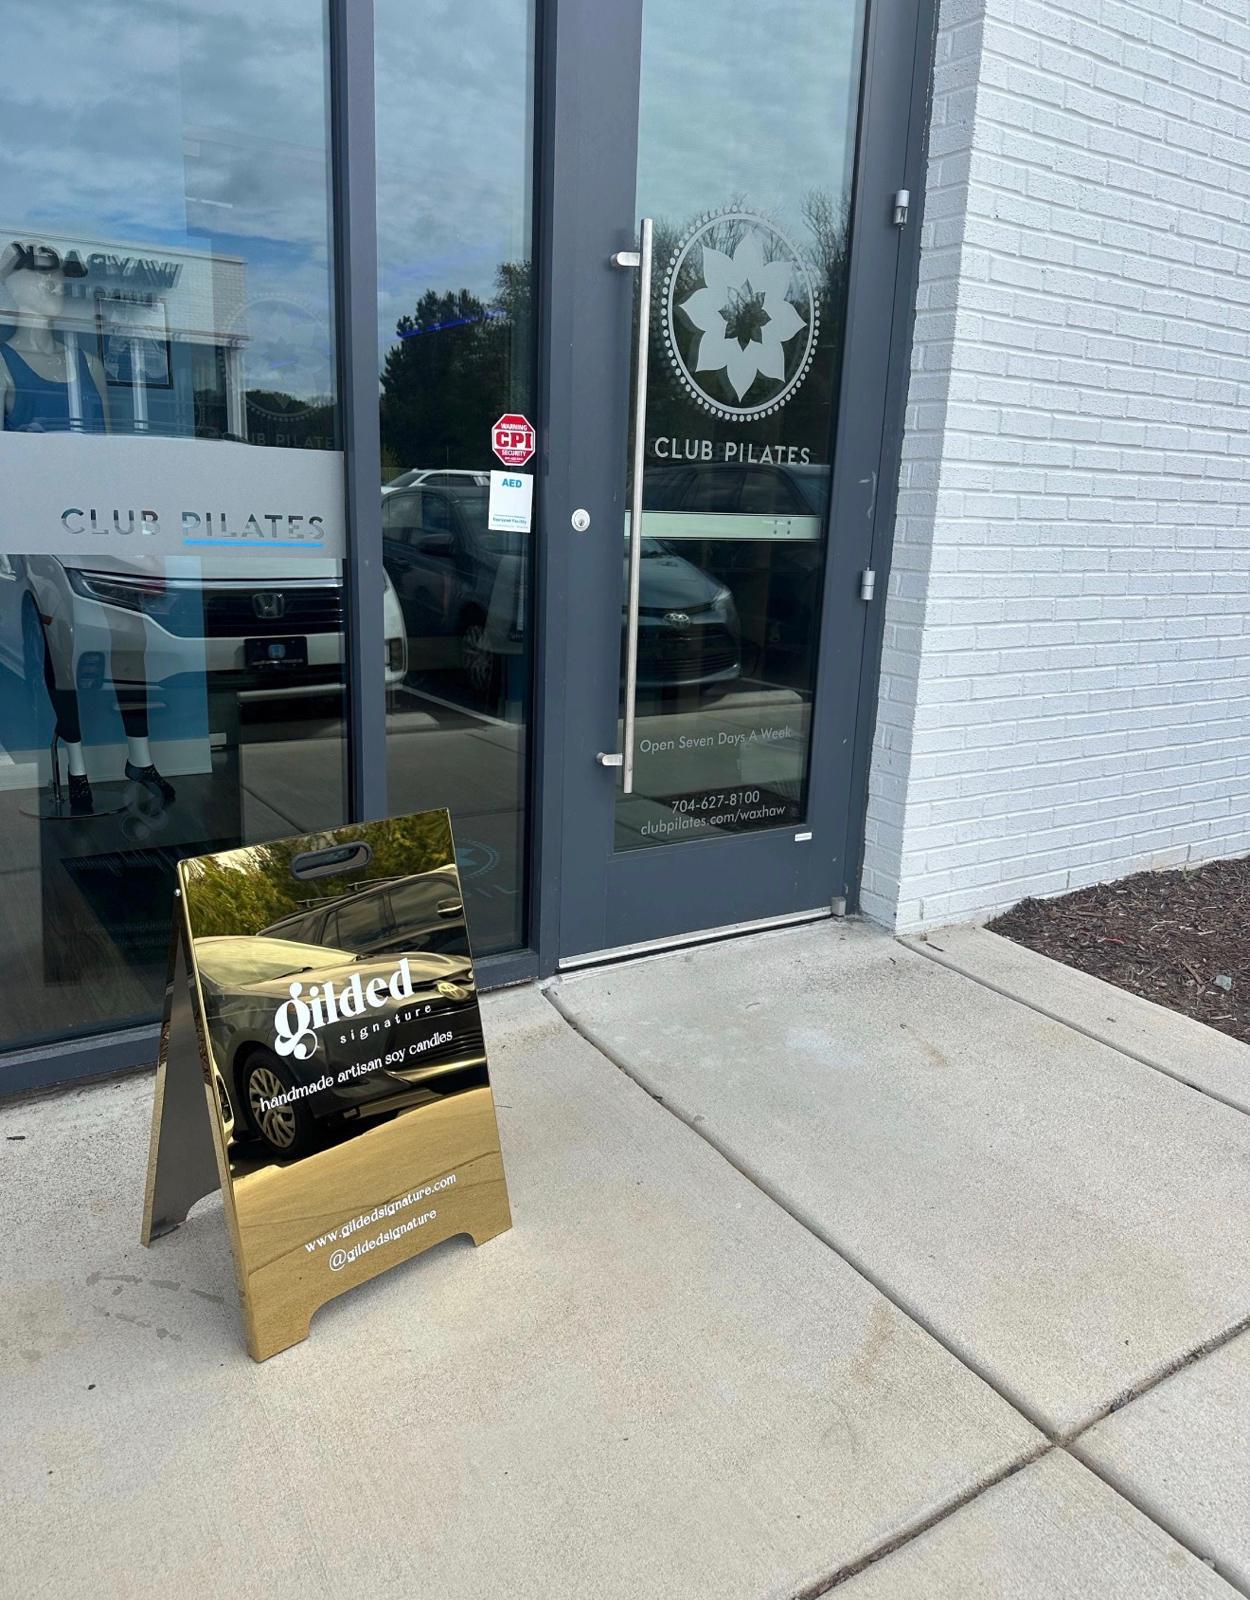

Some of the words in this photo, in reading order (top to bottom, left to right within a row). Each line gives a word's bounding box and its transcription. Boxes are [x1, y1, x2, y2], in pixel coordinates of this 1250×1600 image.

[495, 431, 532, 449] CPI
[501, 423, 528, 431] WARNING
[654, 436, 713, 460] CLUB
[724, 441, 811, 465] PILATES
[502, 478, 522, 488] AED
[61, 508, 161, 536] CLUB
[181, 511, 326, 540] PILATES
[640, 739, 675, 754] Open
[679, 735, 714, 749] Seven
[718, 731, 746, 748] Days
[749, 729, 759, 741] A
[760, 725, 793, 740] Week
[671, 790, 761, 814] 704-627-8100
[640, 805, 786, 836] clubpilates.com/waxhaw
[274, 957, 416, 1060] gilded
[340, 1004, 432, 1044] signature
[260, 1075, 335, 1113] handmade
[337, 1057, 383, 1083] artisan
[385, 1048, 406, 1067] soy
[408, 1030, 453, 1056] candles
[304, 1173, 457, 1253] www.gildedsignature.com
[329, 1209, 437, 1272] @gildedsignature
